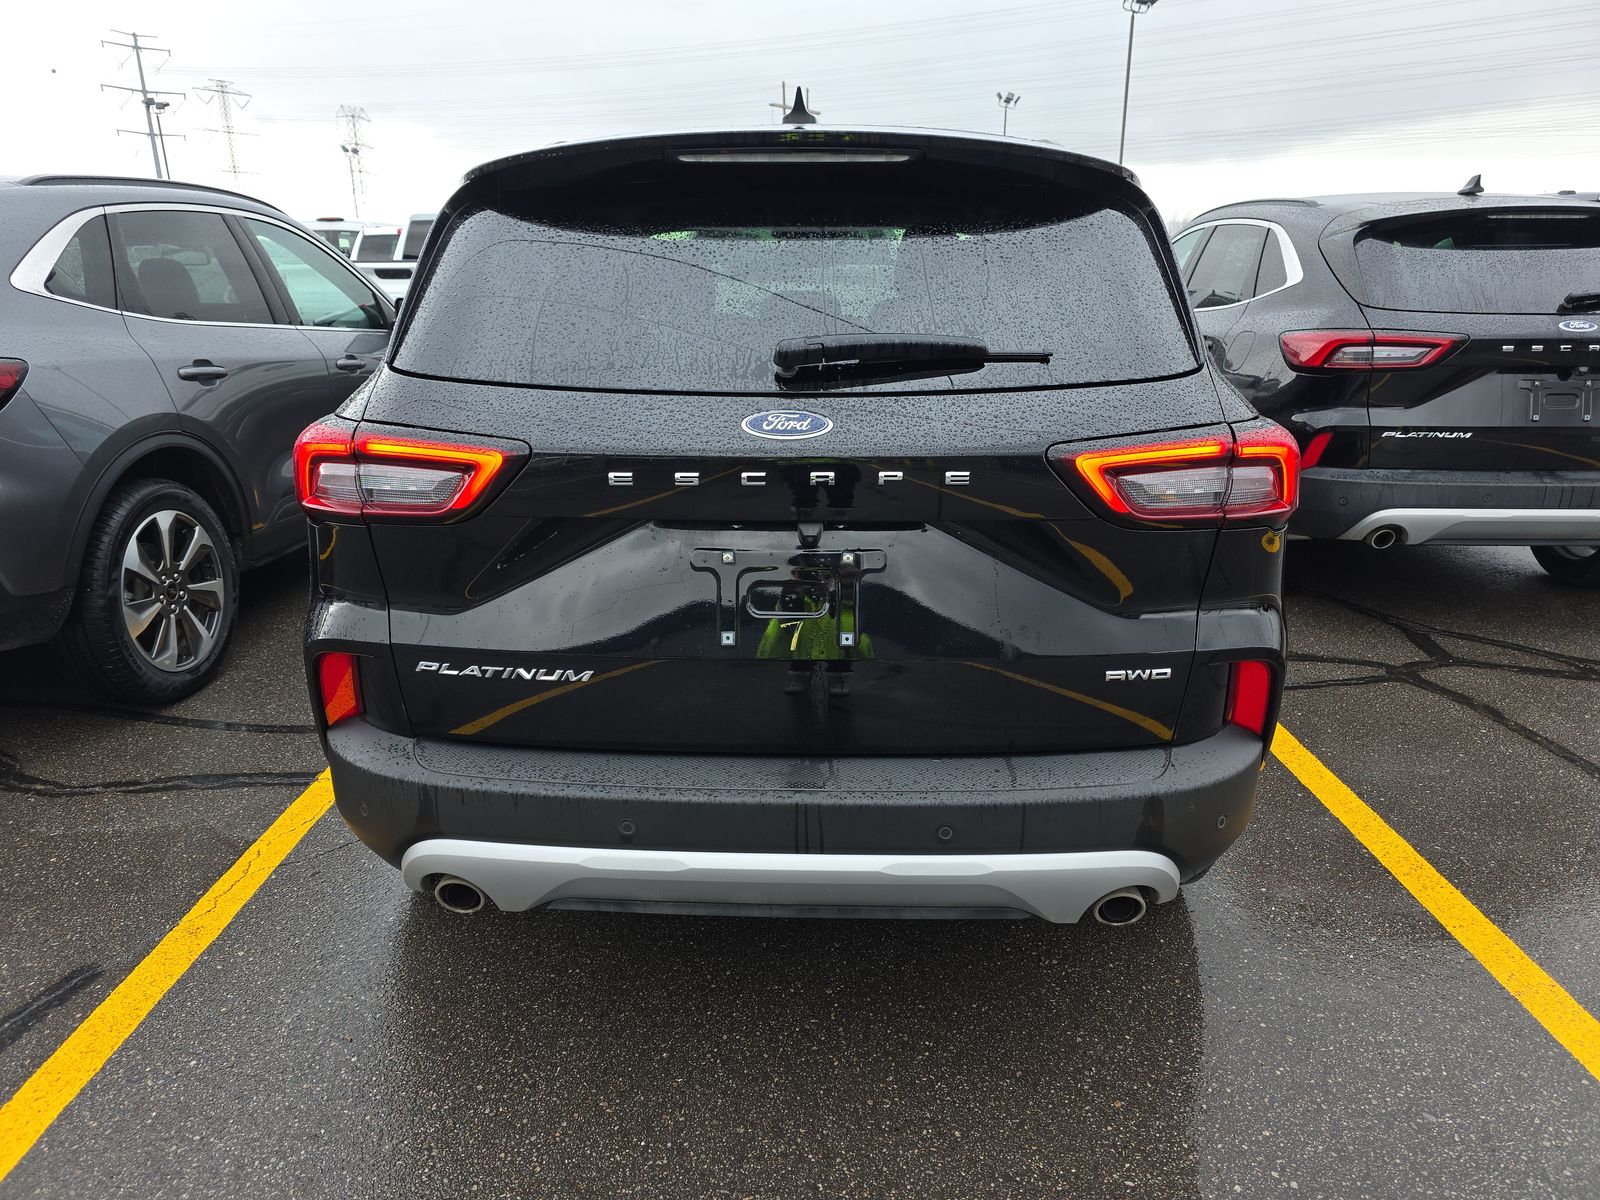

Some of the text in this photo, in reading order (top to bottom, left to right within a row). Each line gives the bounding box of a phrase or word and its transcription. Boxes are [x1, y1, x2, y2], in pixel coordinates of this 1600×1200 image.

[762, 413, 812, 431] Ford
[1381, 431, 1473, 439] PLATINUM
[607, 471, 971, 487] ESCAPE
[415, 660, 595, 683] PLATINUM
[1105, 667, 1172, 682] AWD
